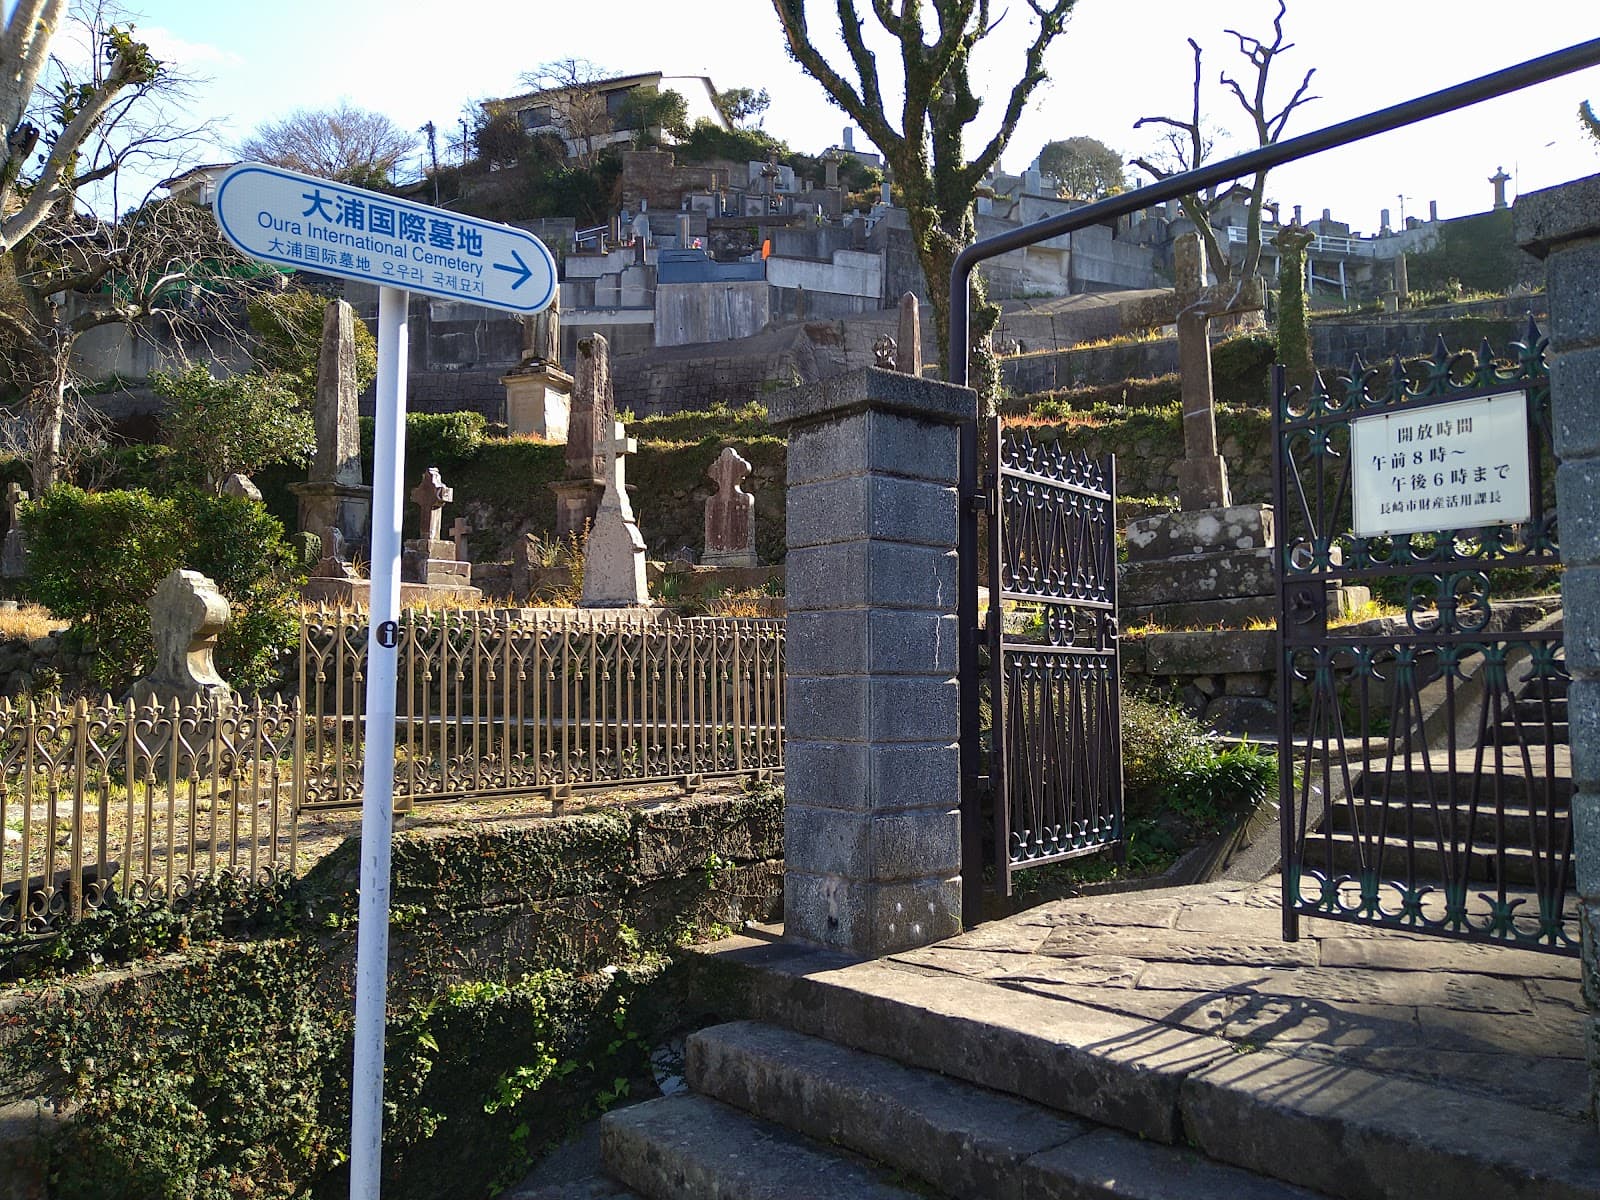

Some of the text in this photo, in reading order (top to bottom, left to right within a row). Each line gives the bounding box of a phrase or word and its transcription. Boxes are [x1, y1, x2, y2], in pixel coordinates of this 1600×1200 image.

[302, 190, 483, 257] 大浦国際墓地
[258, 211, 483, 278] Oura International Cemetery
[268, 237, 371, 273] 大浦国际墓地
[382, 261, 424, 284] 오우라
[1398, 417, 1473, 443] 開放時間
[1392, 463, 1510, 492] 午後6時まで
[1380, 490, 1502, 515] 長崎市財産活用課長
